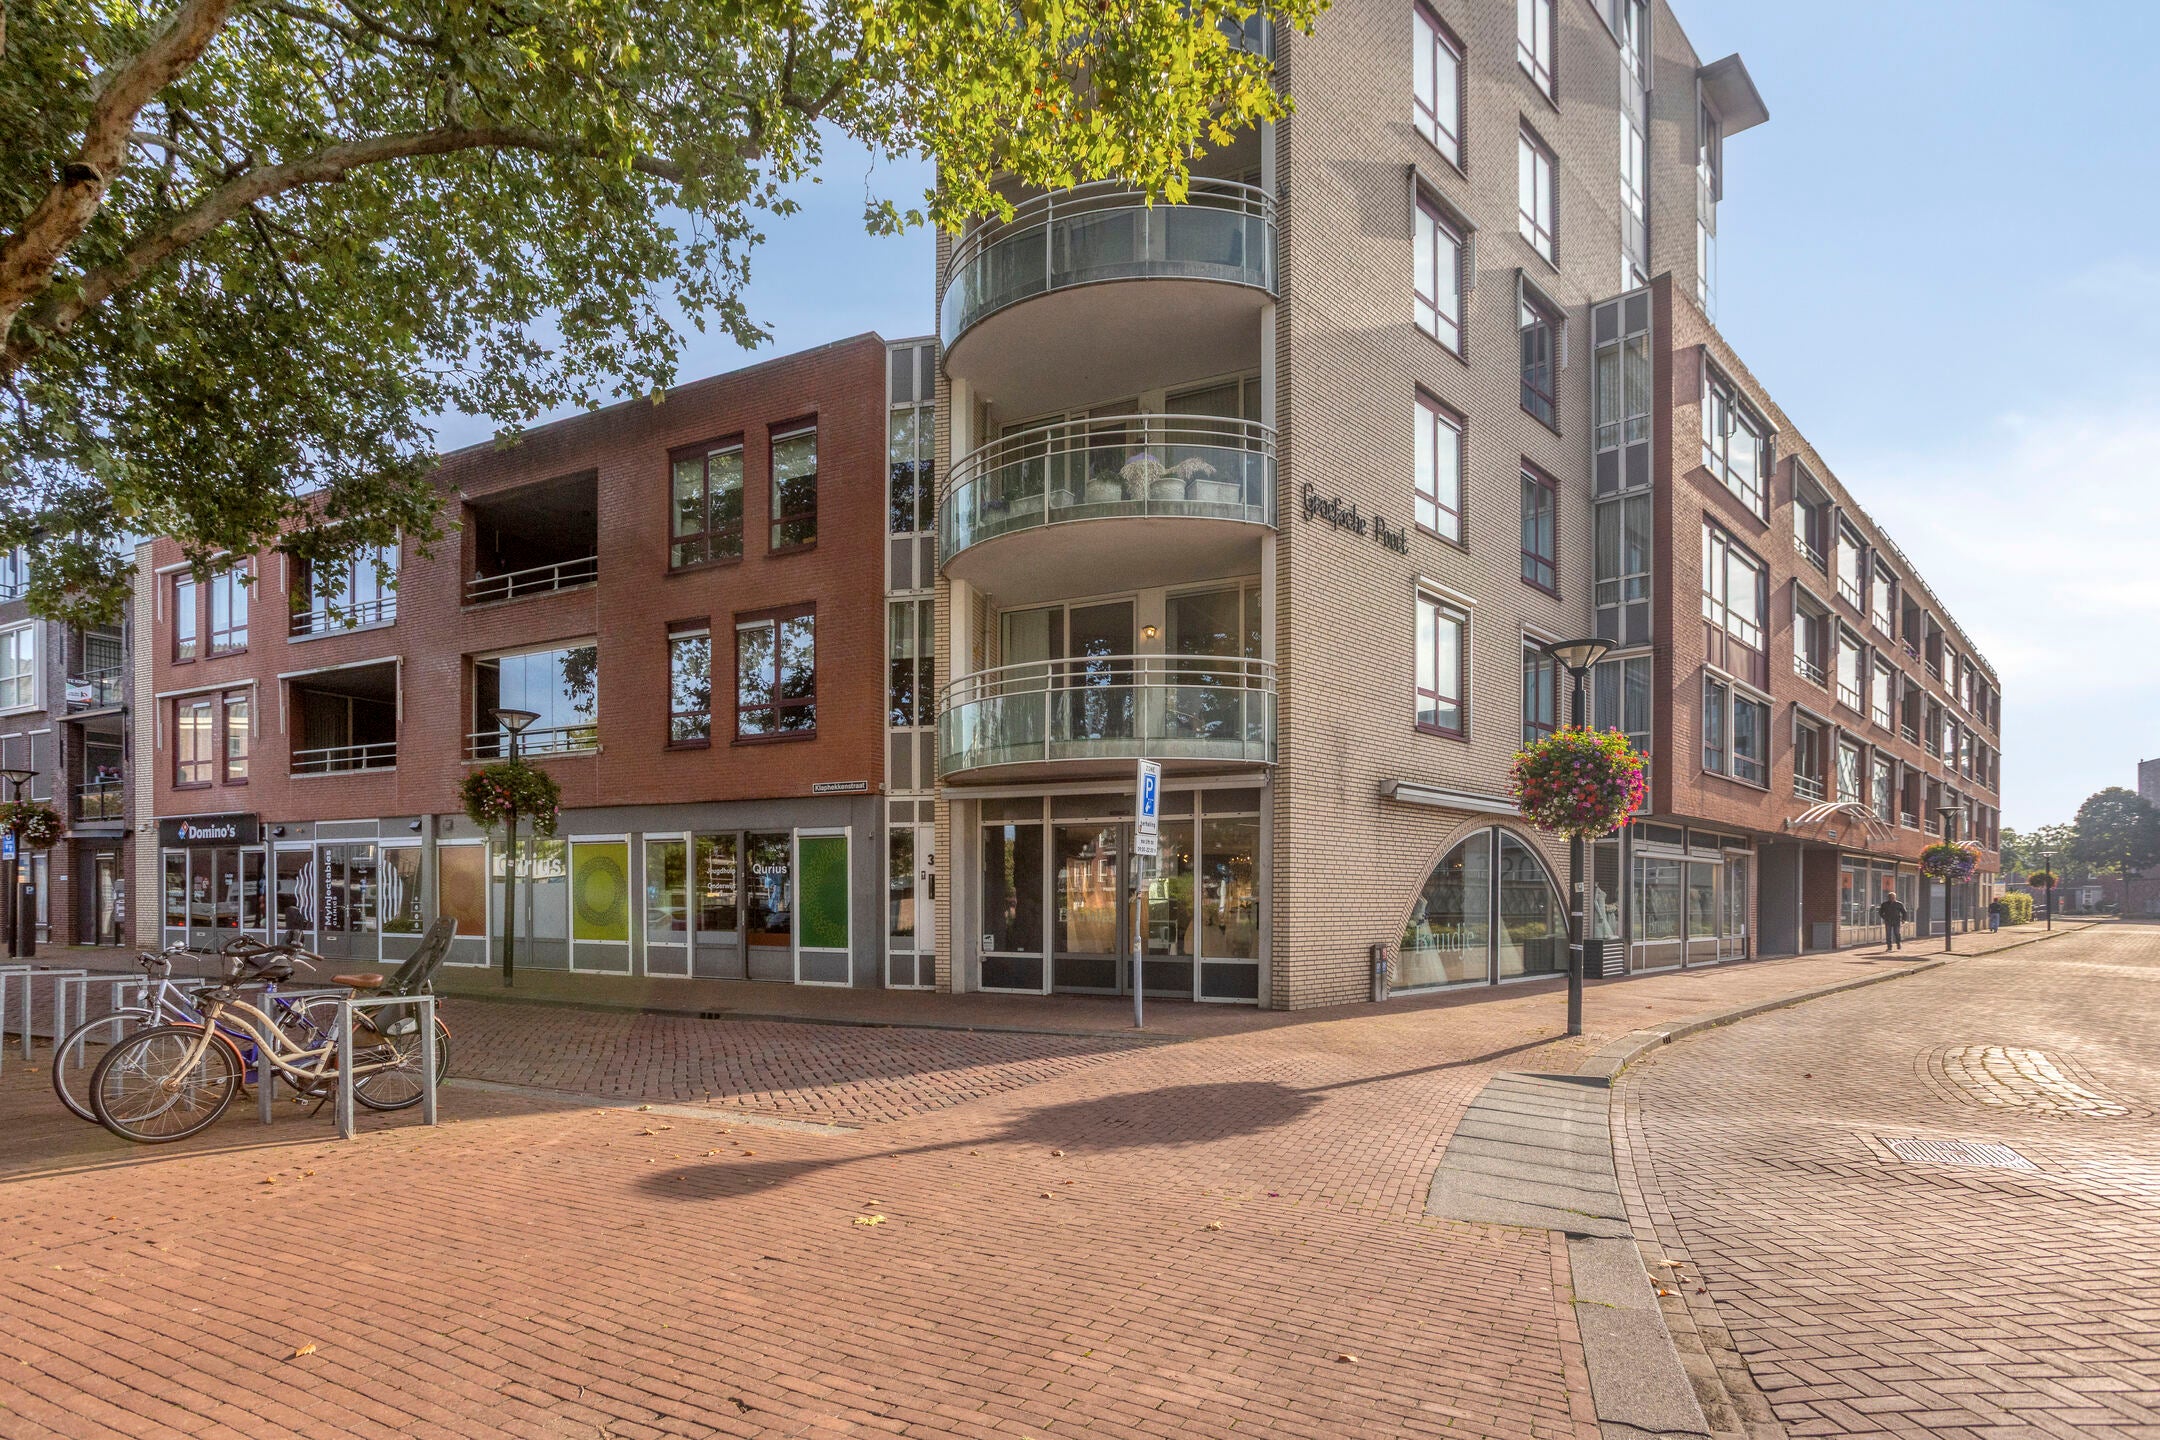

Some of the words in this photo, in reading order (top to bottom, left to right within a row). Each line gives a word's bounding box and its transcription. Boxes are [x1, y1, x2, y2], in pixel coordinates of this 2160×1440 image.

[1375, 515, 1408, 555] Poort
[1145, 777, 1154, 799] P
[189, 823, 236, 839] Domino's
[927, 854, 934, 866] 3
[752, 863, 787, 874] Qurius
